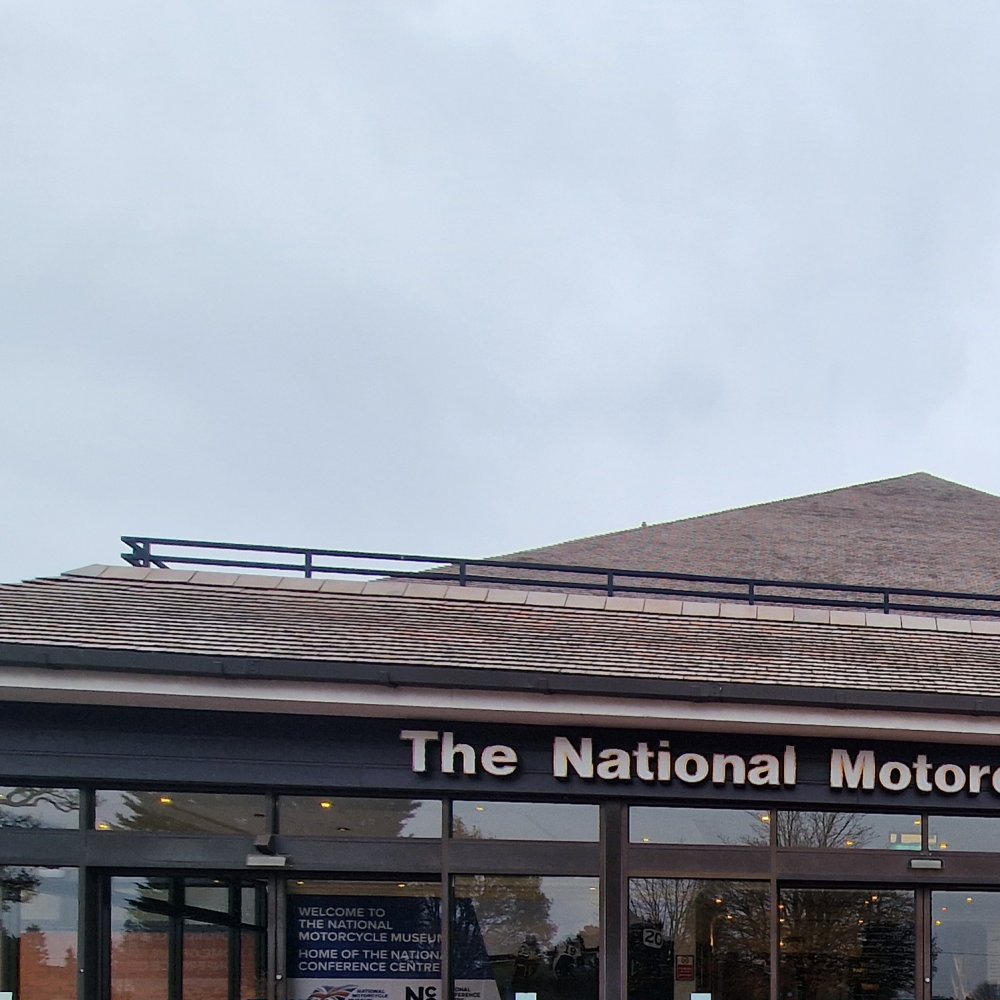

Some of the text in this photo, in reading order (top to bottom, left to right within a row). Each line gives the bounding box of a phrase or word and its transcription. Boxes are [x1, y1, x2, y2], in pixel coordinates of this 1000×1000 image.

[401, 730, 517, 775] The
[553, 736, 797, 786] National
[298, 906, 385, 917] WELCOME TO
[299, 919, 393, 930] THE NATIONAL
[299, 932, 387, 943] MOTORCYCLE
[645, 931, 662, 945] 20
[299, 950, 442, 961] HOME OF THE NATION
[299, 961, 441, 972] CONFERENCE CENTRE
